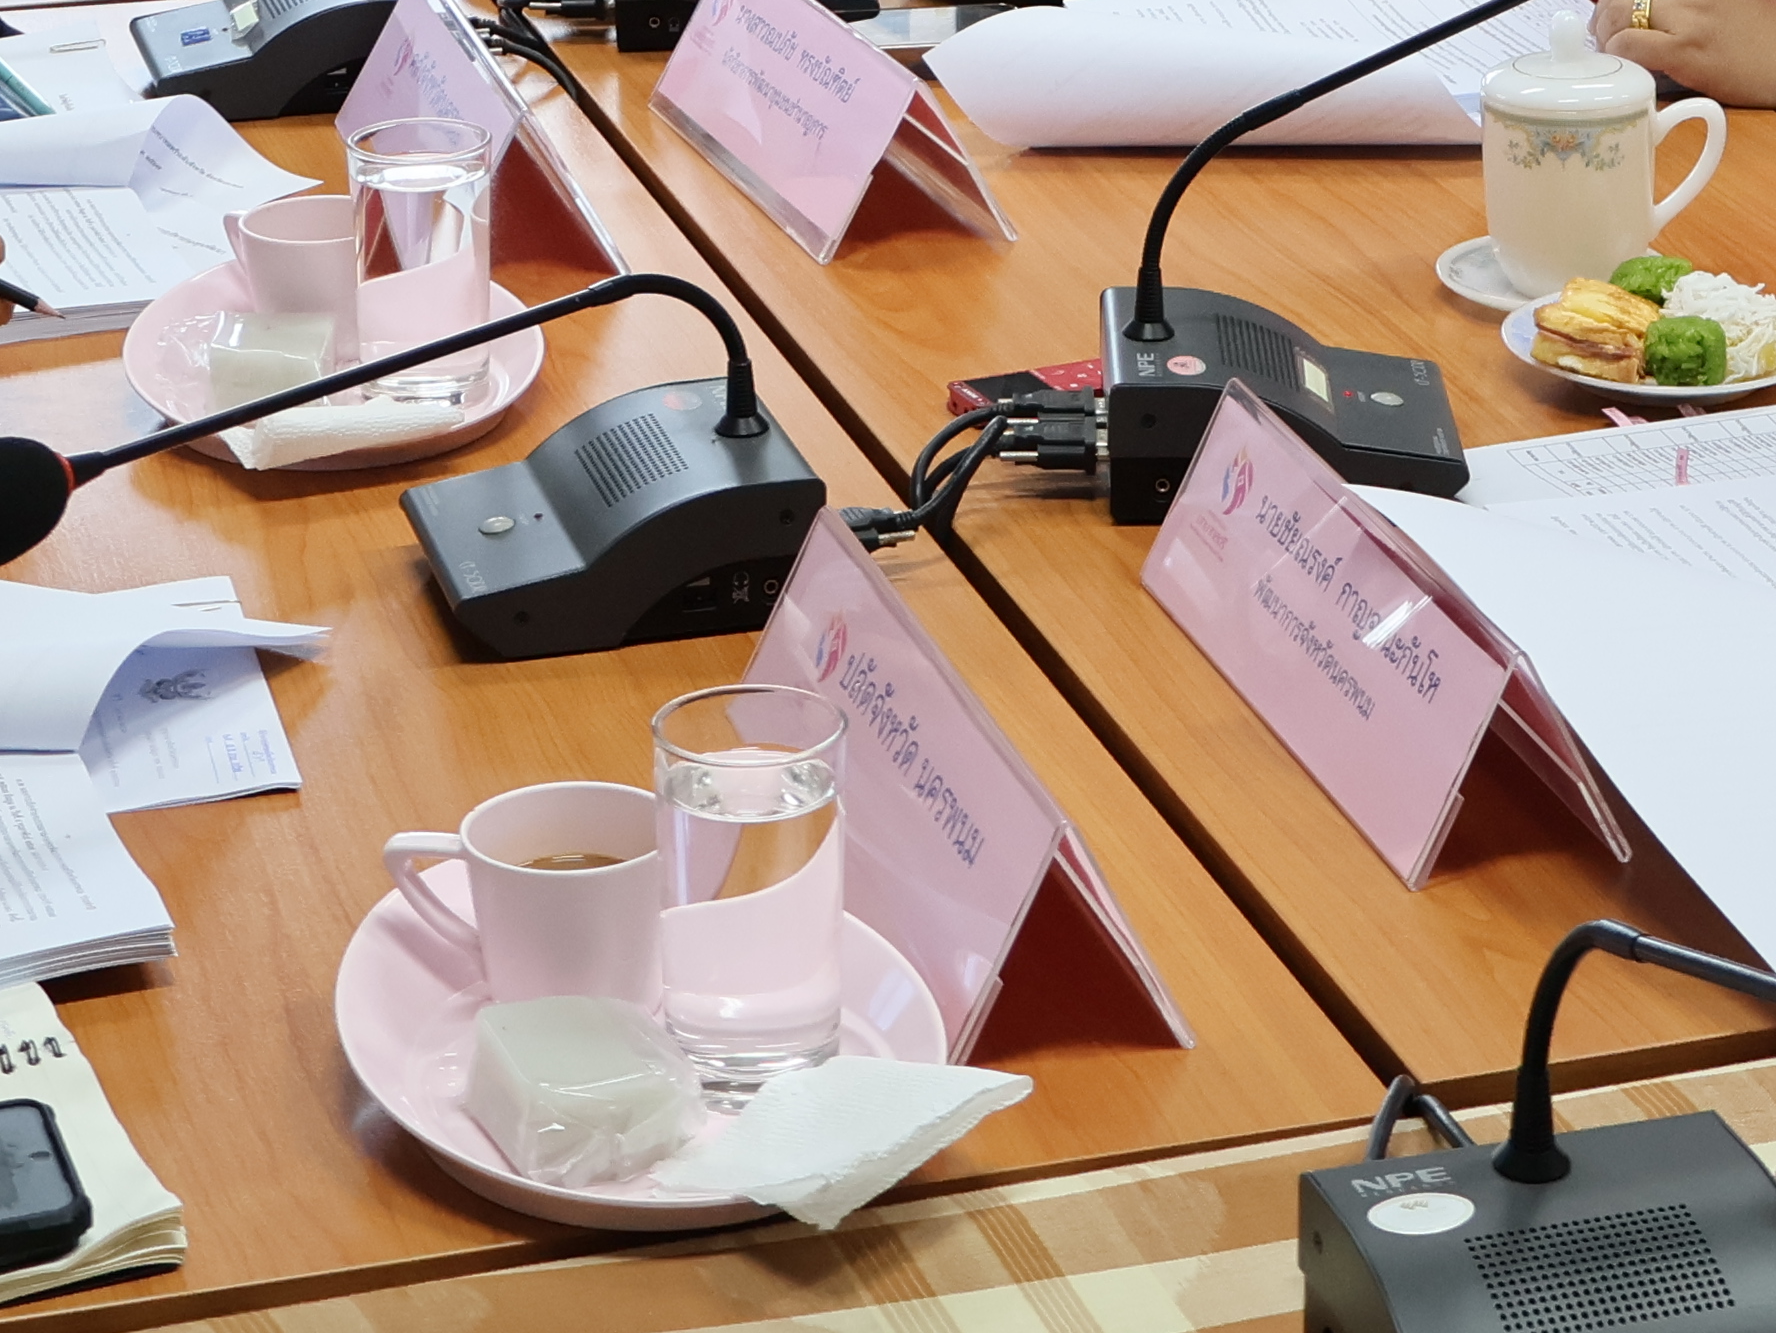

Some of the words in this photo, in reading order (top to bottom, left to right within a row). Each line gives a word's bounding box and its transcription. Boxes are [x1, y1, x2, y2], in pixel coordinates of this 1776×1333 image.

[1137, 352, 1155, 378] NPE
[1255, 494, 1344, 593] นายชัยณรงค์
[1253, 574, 1376, 722] พัฒนาการจังหวัดนครพนม
[837, 653, 921, 771] ปลัดจังหวัด
[918, 757, 986, 871] นครพนม
[1351, 1166, 1452, 1193] NPE
